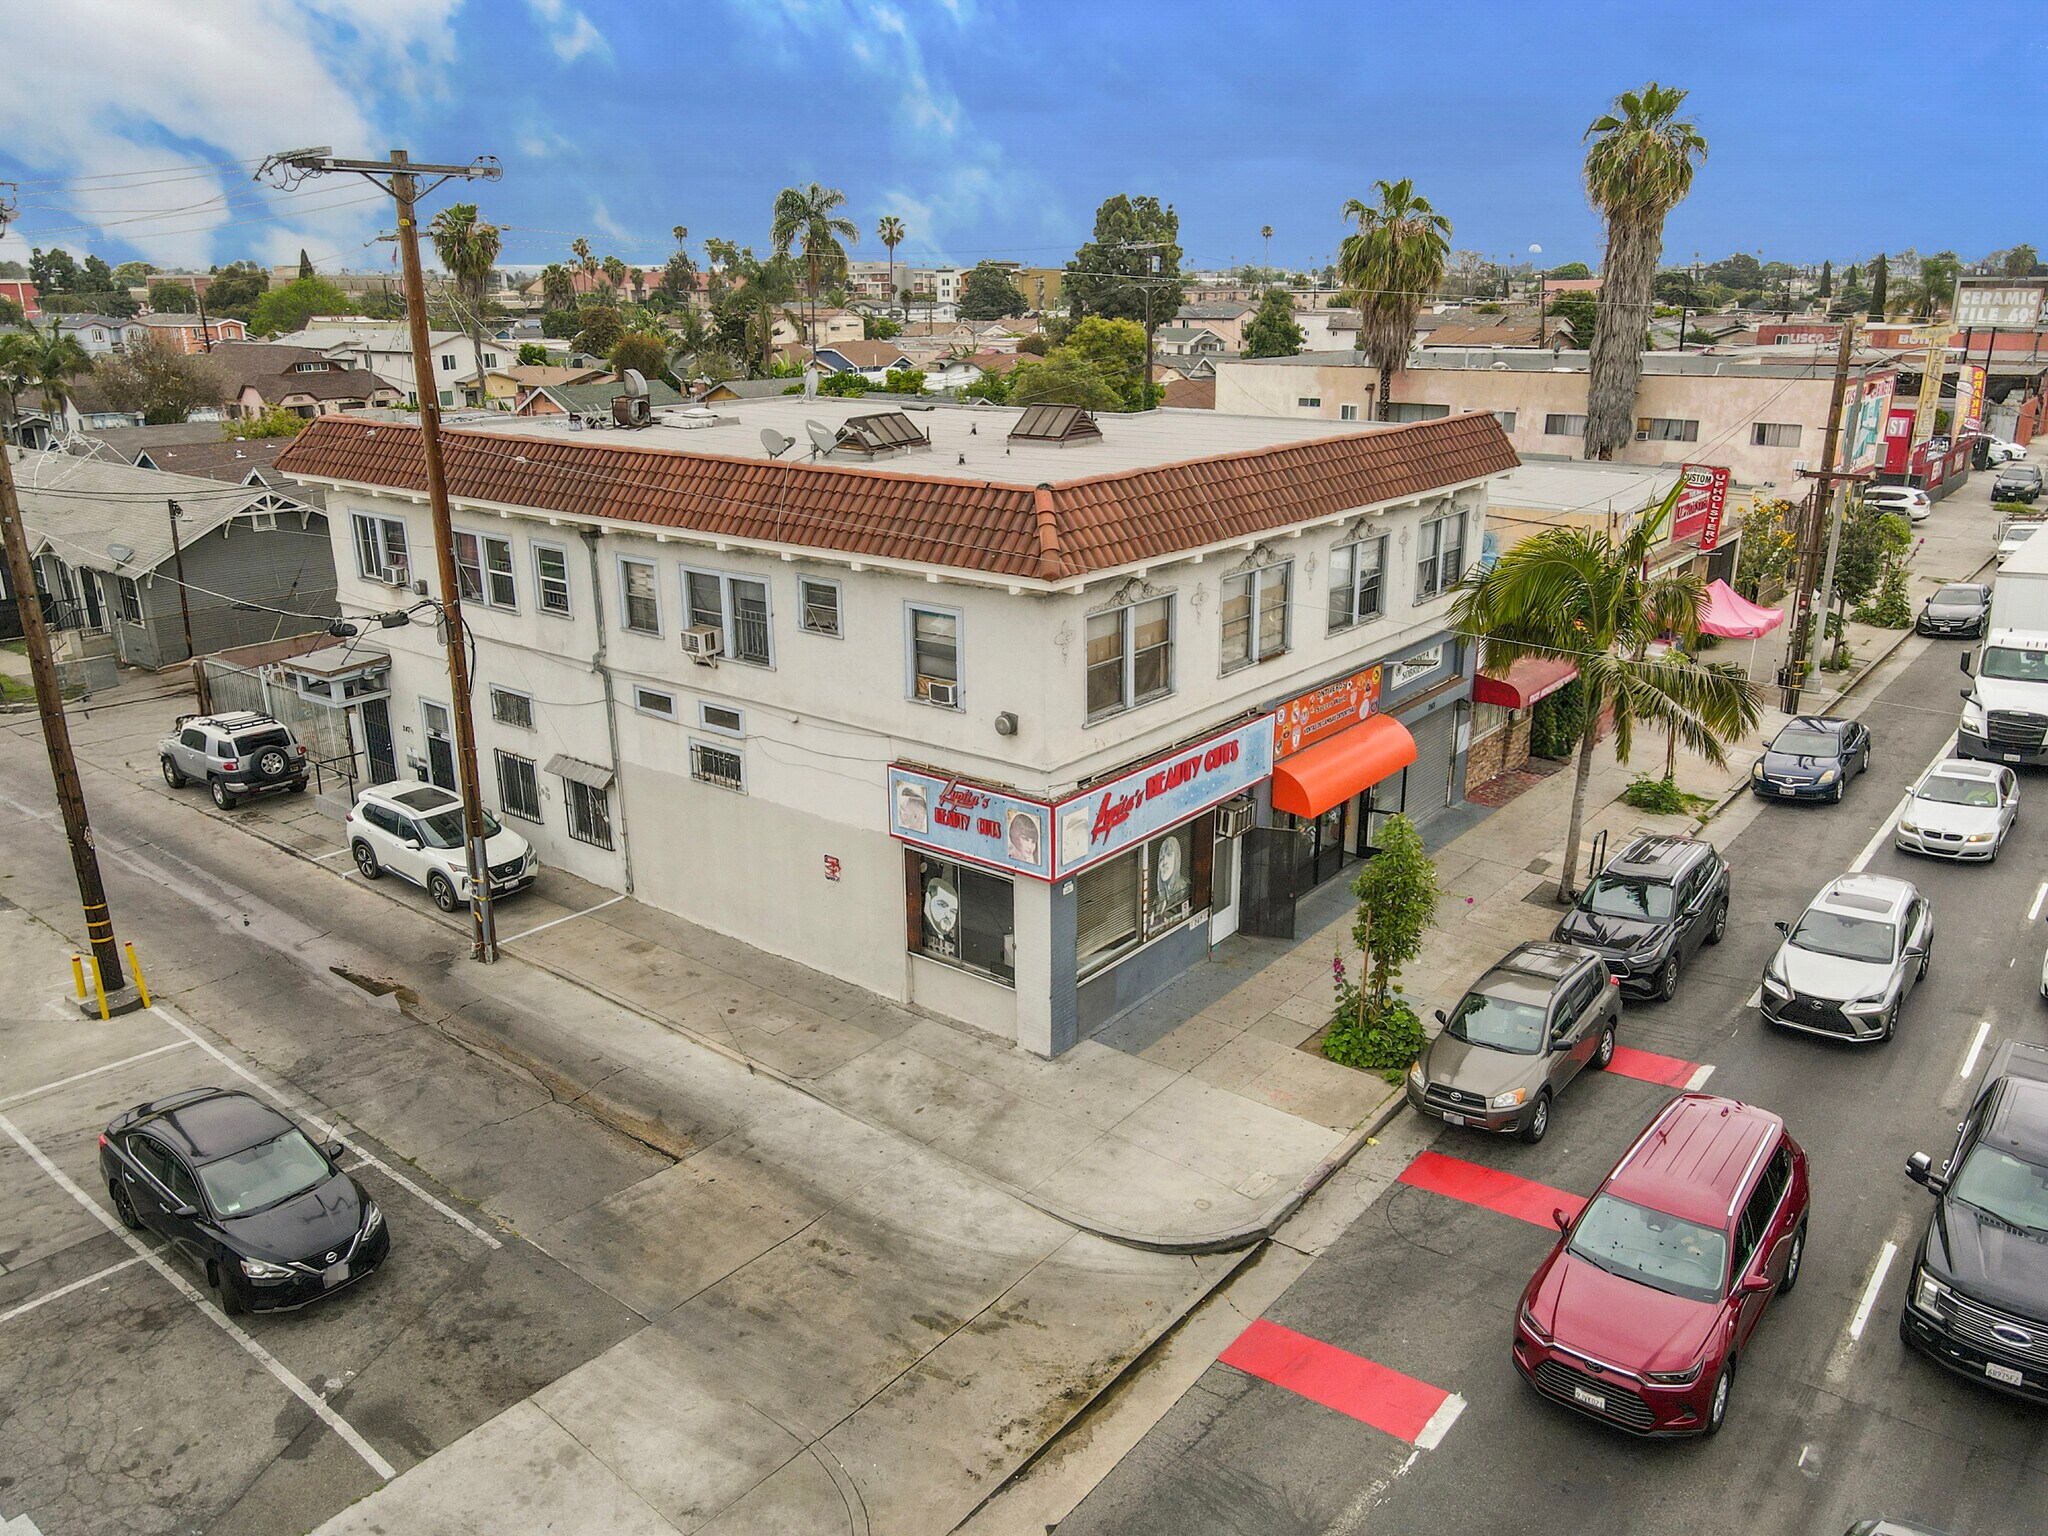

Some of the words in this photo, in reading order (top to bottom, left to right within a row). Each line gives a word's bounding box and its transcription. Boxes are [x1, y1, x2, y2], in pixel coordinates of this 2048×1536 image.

[1961, 291, 2039, 305] CERAMIC
[1958, 307, 1999, 324] TILE
[1682, 472, 1712, 484] CUSTOM
[1704, 474, 1726, 544] UPHOLSTERY
[1315, 681, 1347, 699] ONTIVEROS
[938, 778, 992, 812] Lupita's
[1090, 788, 1145, 847] Lupita's
[1145, 754, 1202, 802] BEAUTY
[1204, 738, 1240, 773] CUTS
[934, 807, 971, 831] BEAUTY
[976, 817, 1002, 839] CUTS
